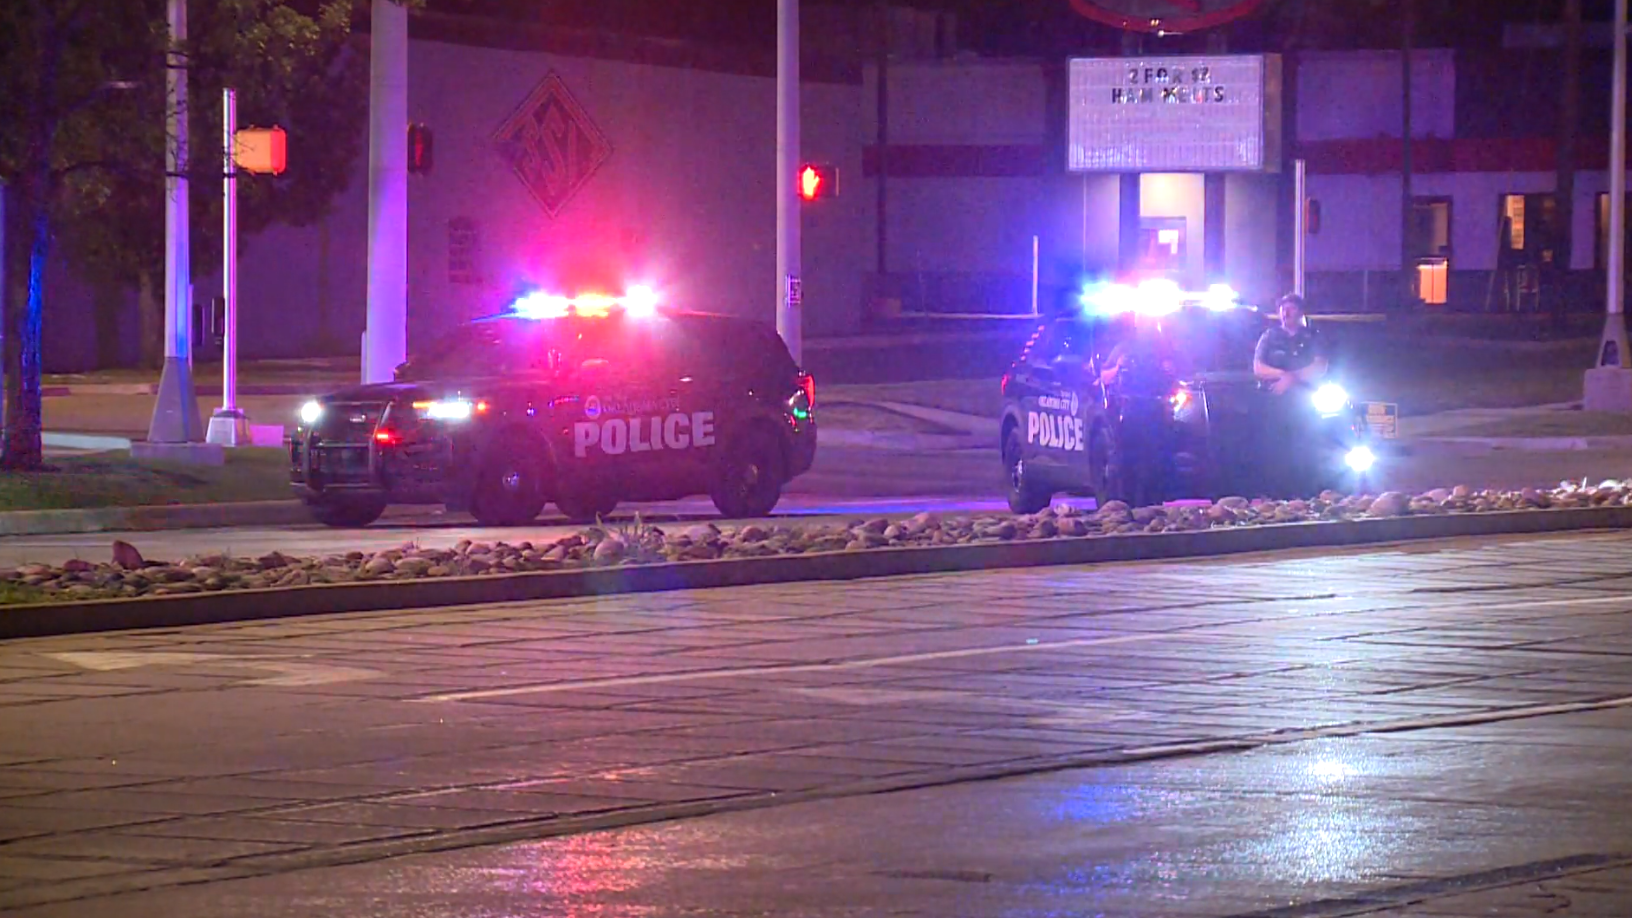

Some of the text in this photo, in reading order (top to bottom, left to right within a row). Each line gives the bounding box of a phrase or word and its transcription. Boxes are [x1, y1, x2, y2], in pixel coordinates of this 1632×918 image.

[1144, 67, 1182, 84] FOR
[574, 411, 716, 458] POLICE
[1028, 411, 1084, 451] POLICE
